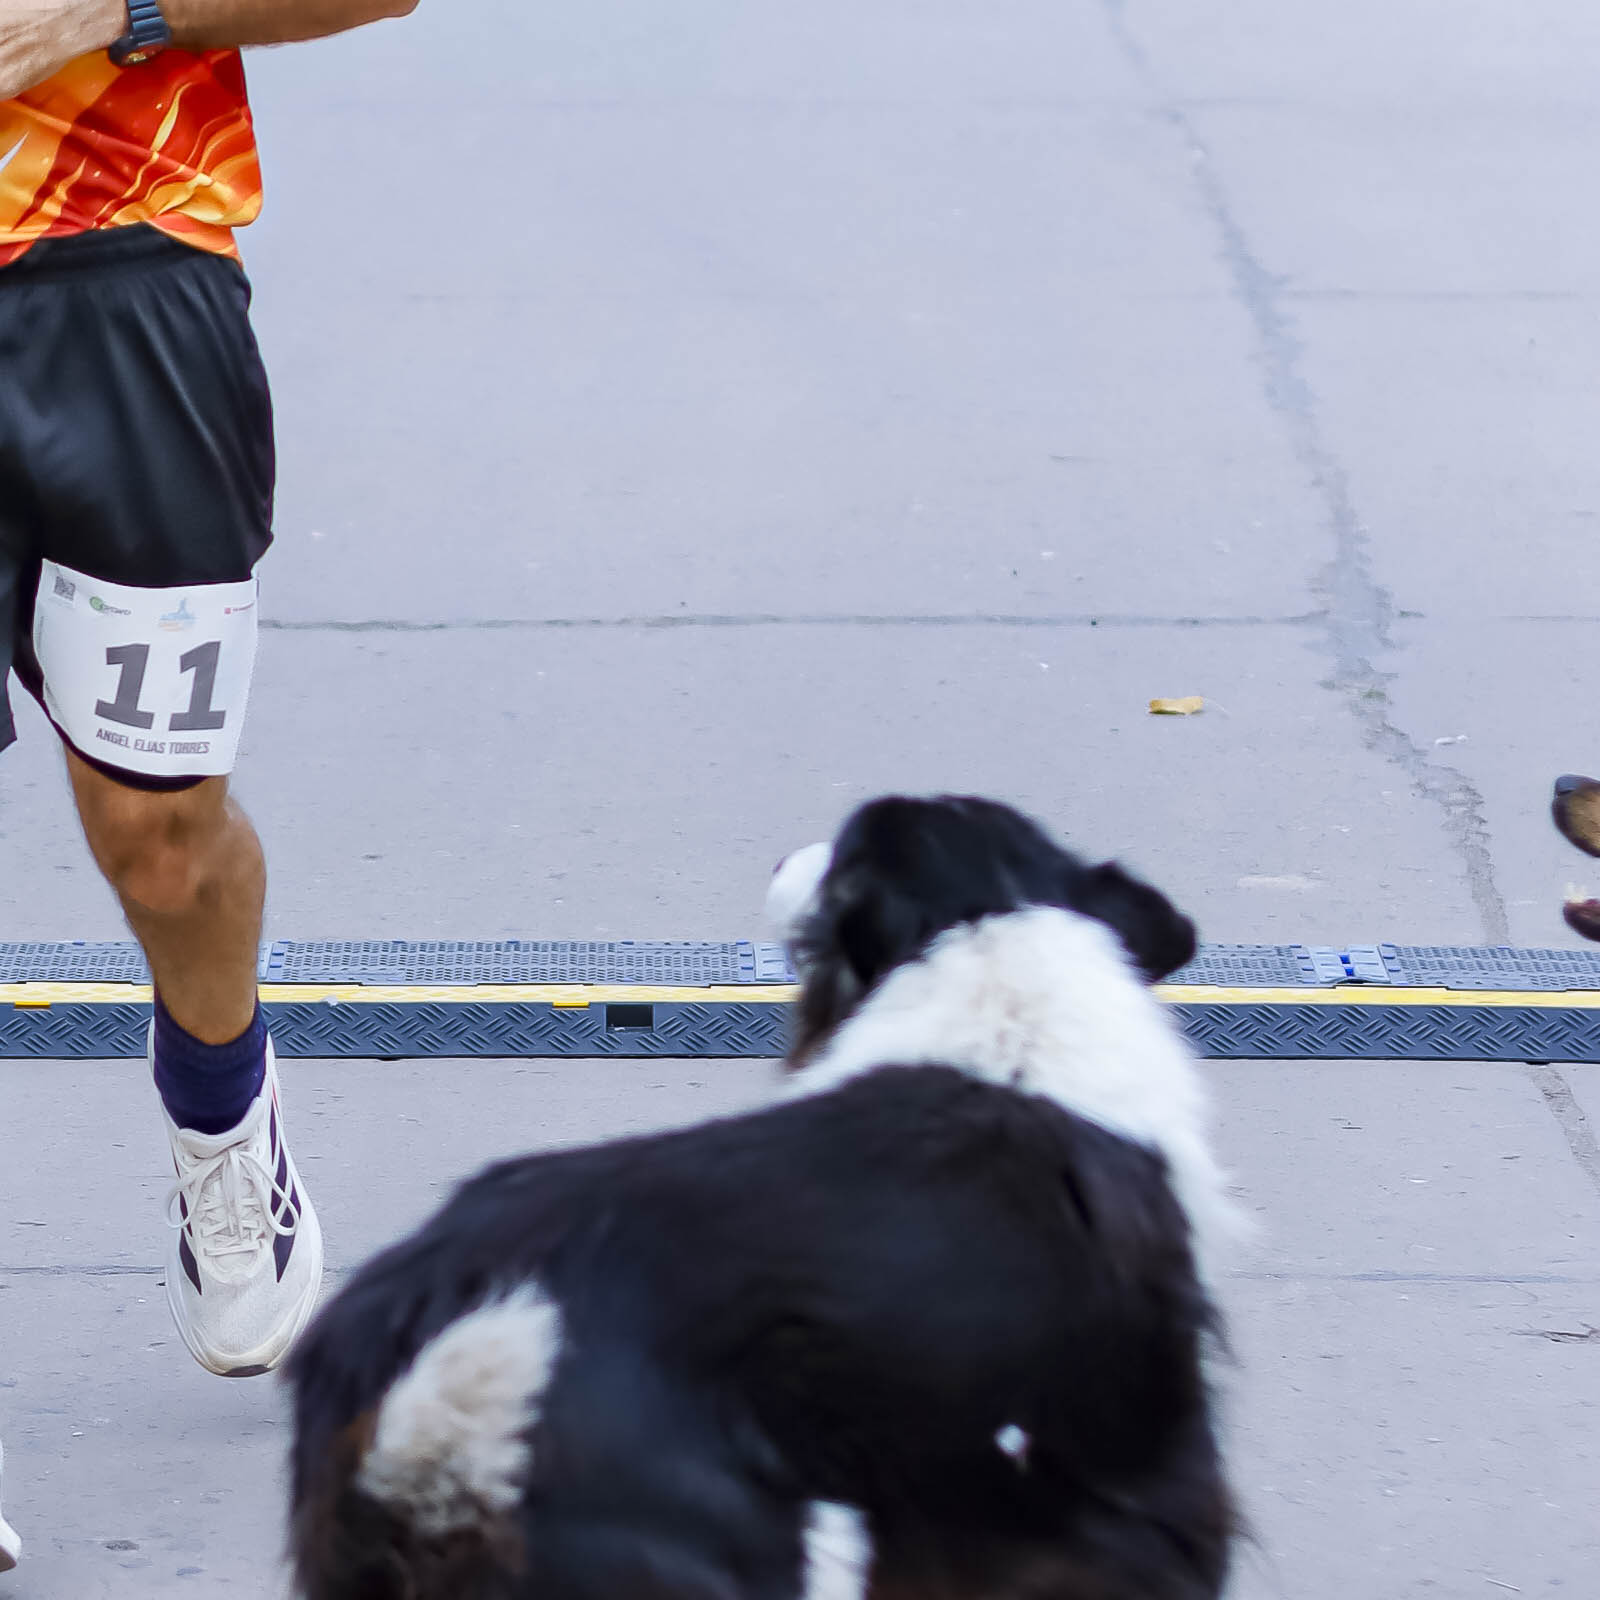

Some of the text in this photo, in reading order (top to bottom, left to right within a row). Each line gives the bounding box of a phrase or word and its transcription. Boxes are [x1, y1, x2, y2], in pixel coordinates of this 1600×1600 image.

[95, 641, 226, 731] 11
[96, 728, 210, 754] ANGEL ELIAS TORRES
